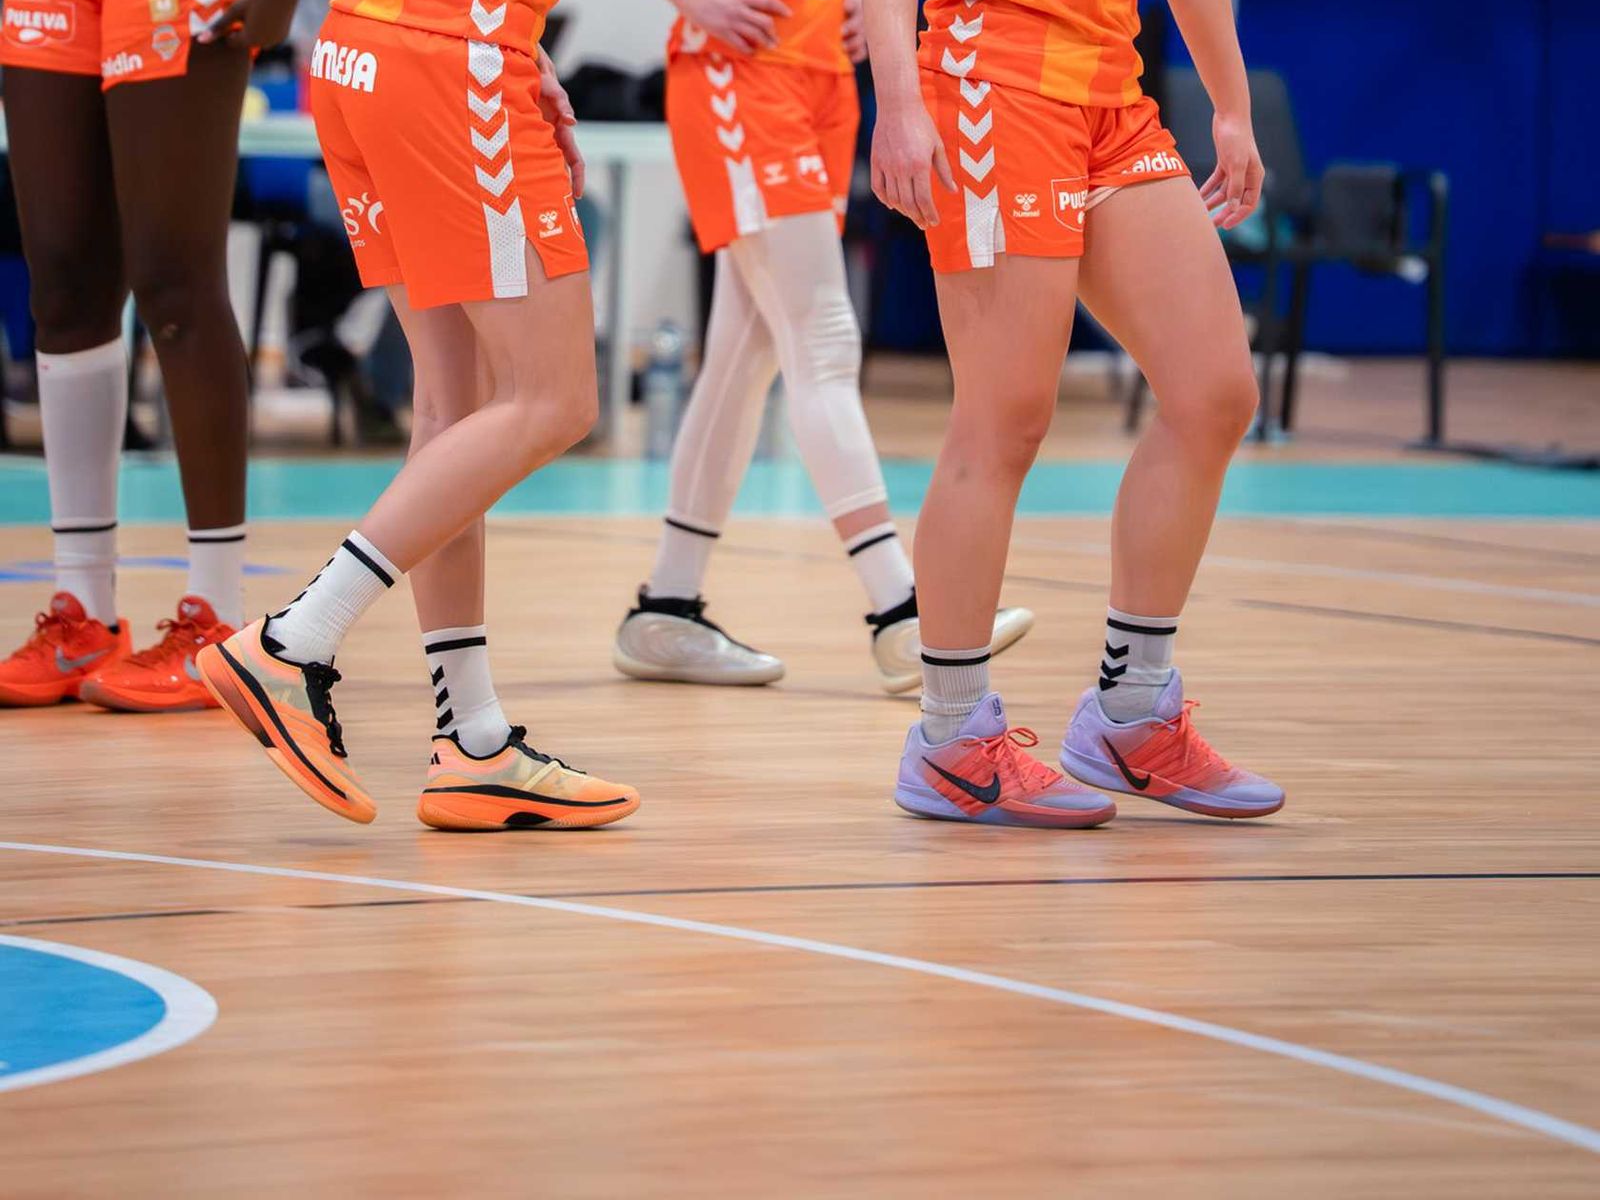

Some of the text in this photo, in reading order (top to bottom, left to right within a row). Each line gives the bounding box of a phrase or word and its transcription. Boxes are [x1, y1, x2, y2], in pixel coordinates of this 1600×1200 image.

[5, 7, 68, 32] PULEVA
[310, 38, 378, 93] AMESA
[1121, 151, 1184, 176] aldin
